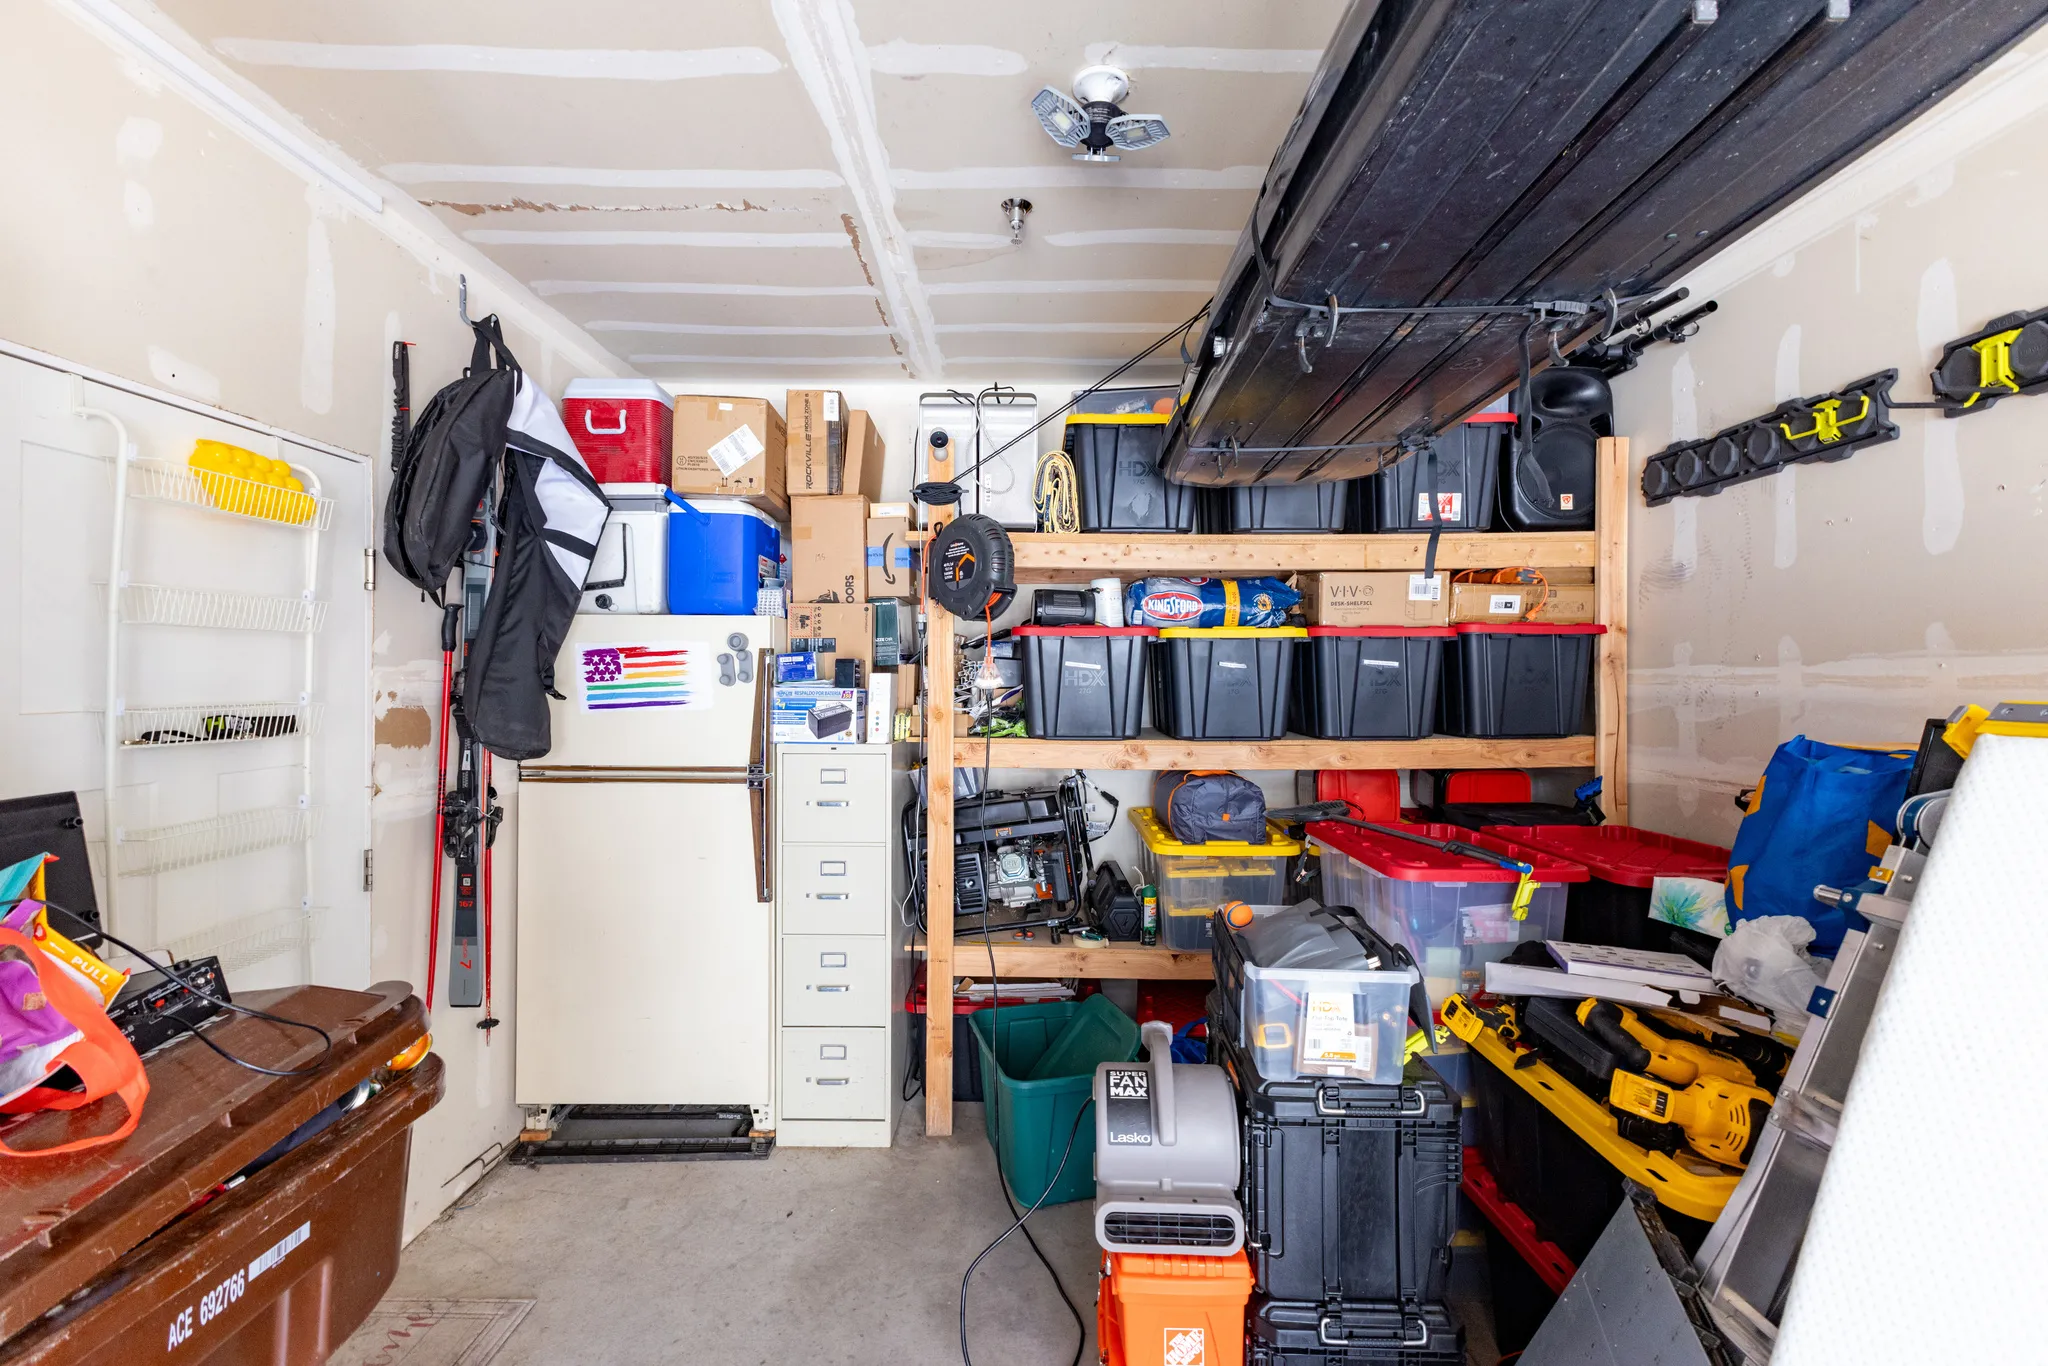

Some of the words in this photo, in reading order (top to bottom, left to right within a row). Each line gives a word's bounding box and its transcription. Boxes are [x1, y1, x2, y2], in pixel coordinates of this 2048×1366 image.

[805, 433, 813, 489] ROCKVILLE
[1118, 460, 1158, 477] HDX
[1147, 596, 1199, 617] KINGSFORD
[1064, 670, 1106, 687] HDX
[71, 955, 109, 985] PULL
[460, 959, 472, 970] 7
[1109, 1076, 1148, 1088] FAN
[1110, 1086, 1148, 1097] MAX
[1110, 1132, 1151, 1143] Lasko
[167, 1306, 193, 1352] ACE
[199, 1269, 246, 1327] 692766
[1166, 1329, 1202, 1365] HOME
